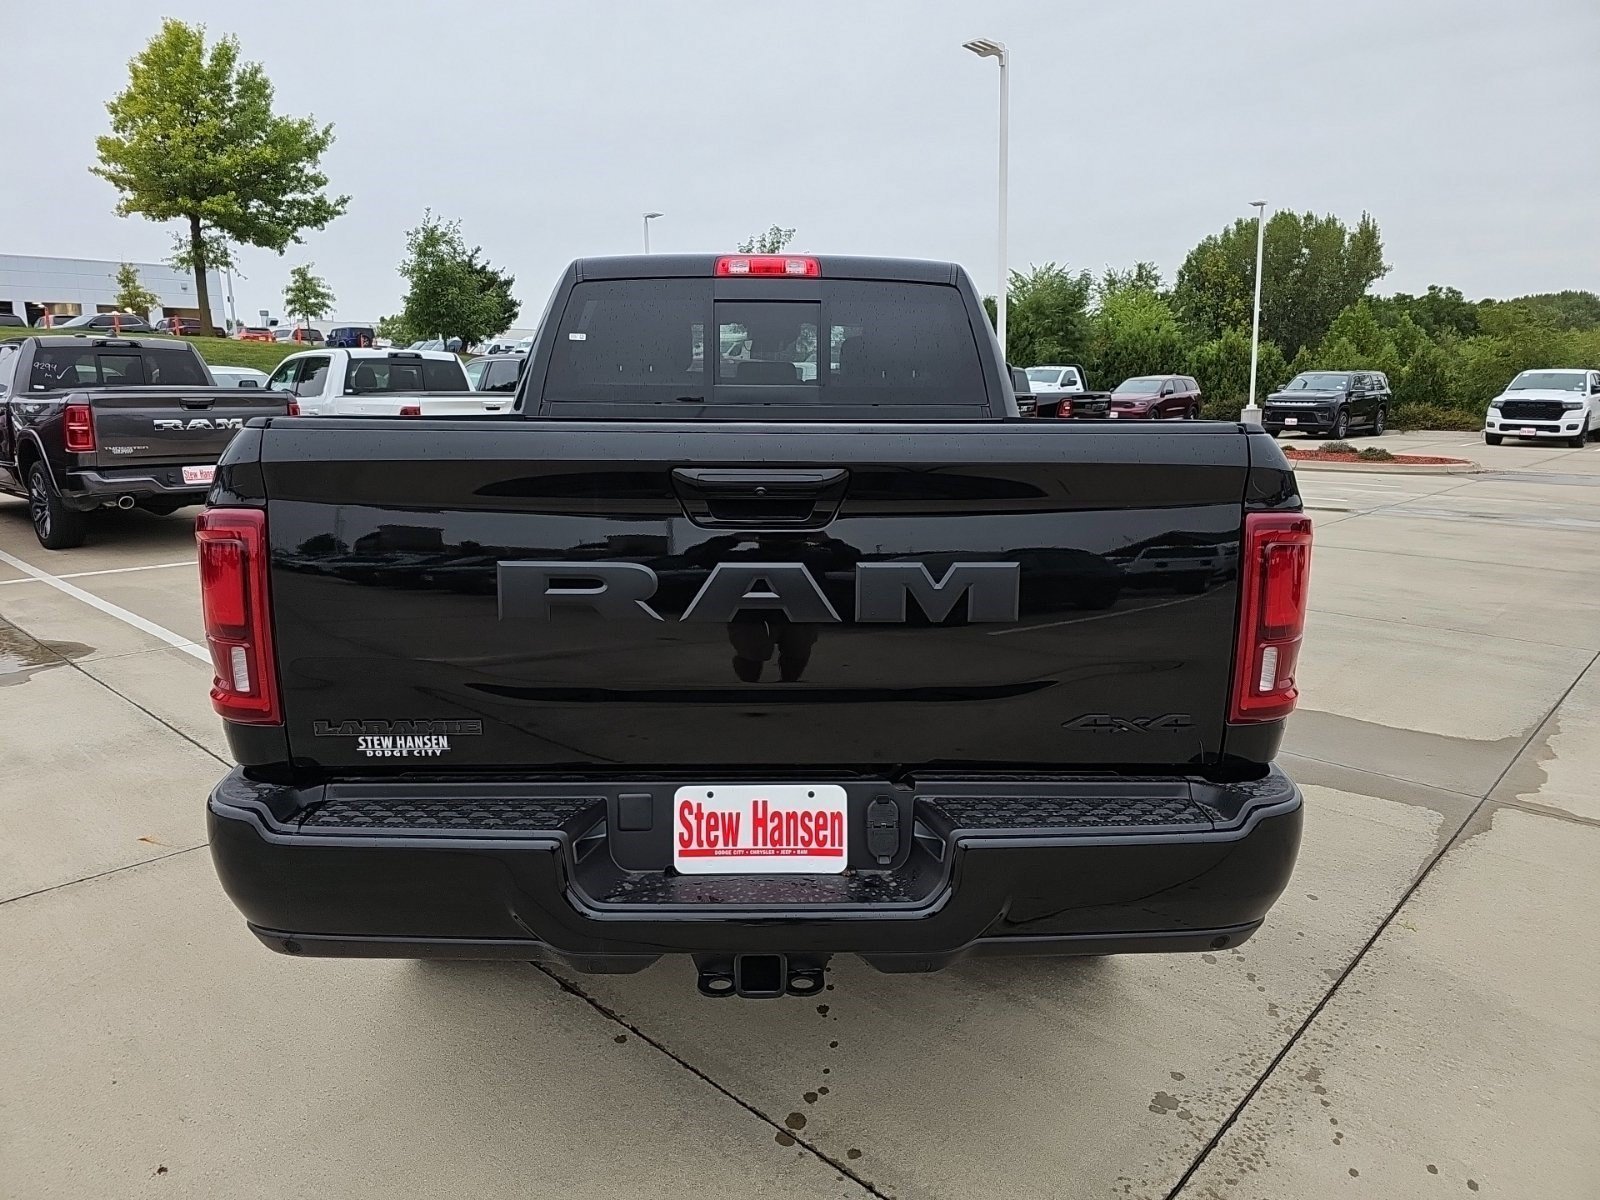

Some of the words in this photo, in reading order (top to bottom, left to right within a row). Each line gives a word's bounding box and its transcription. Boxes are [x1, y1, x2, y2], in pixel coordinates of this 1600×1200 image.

[153, 418, 244, 431] RAM
[496, 560, 1021, 623] RAM
[313, 719, 483, 737] LARAMIE
[357, 735, 393, 749] STEW
[396, 735, 449, 749] HANSEN
[678, 800, 741, 848] Stew
[752, 800, 844, 848] Hansen
